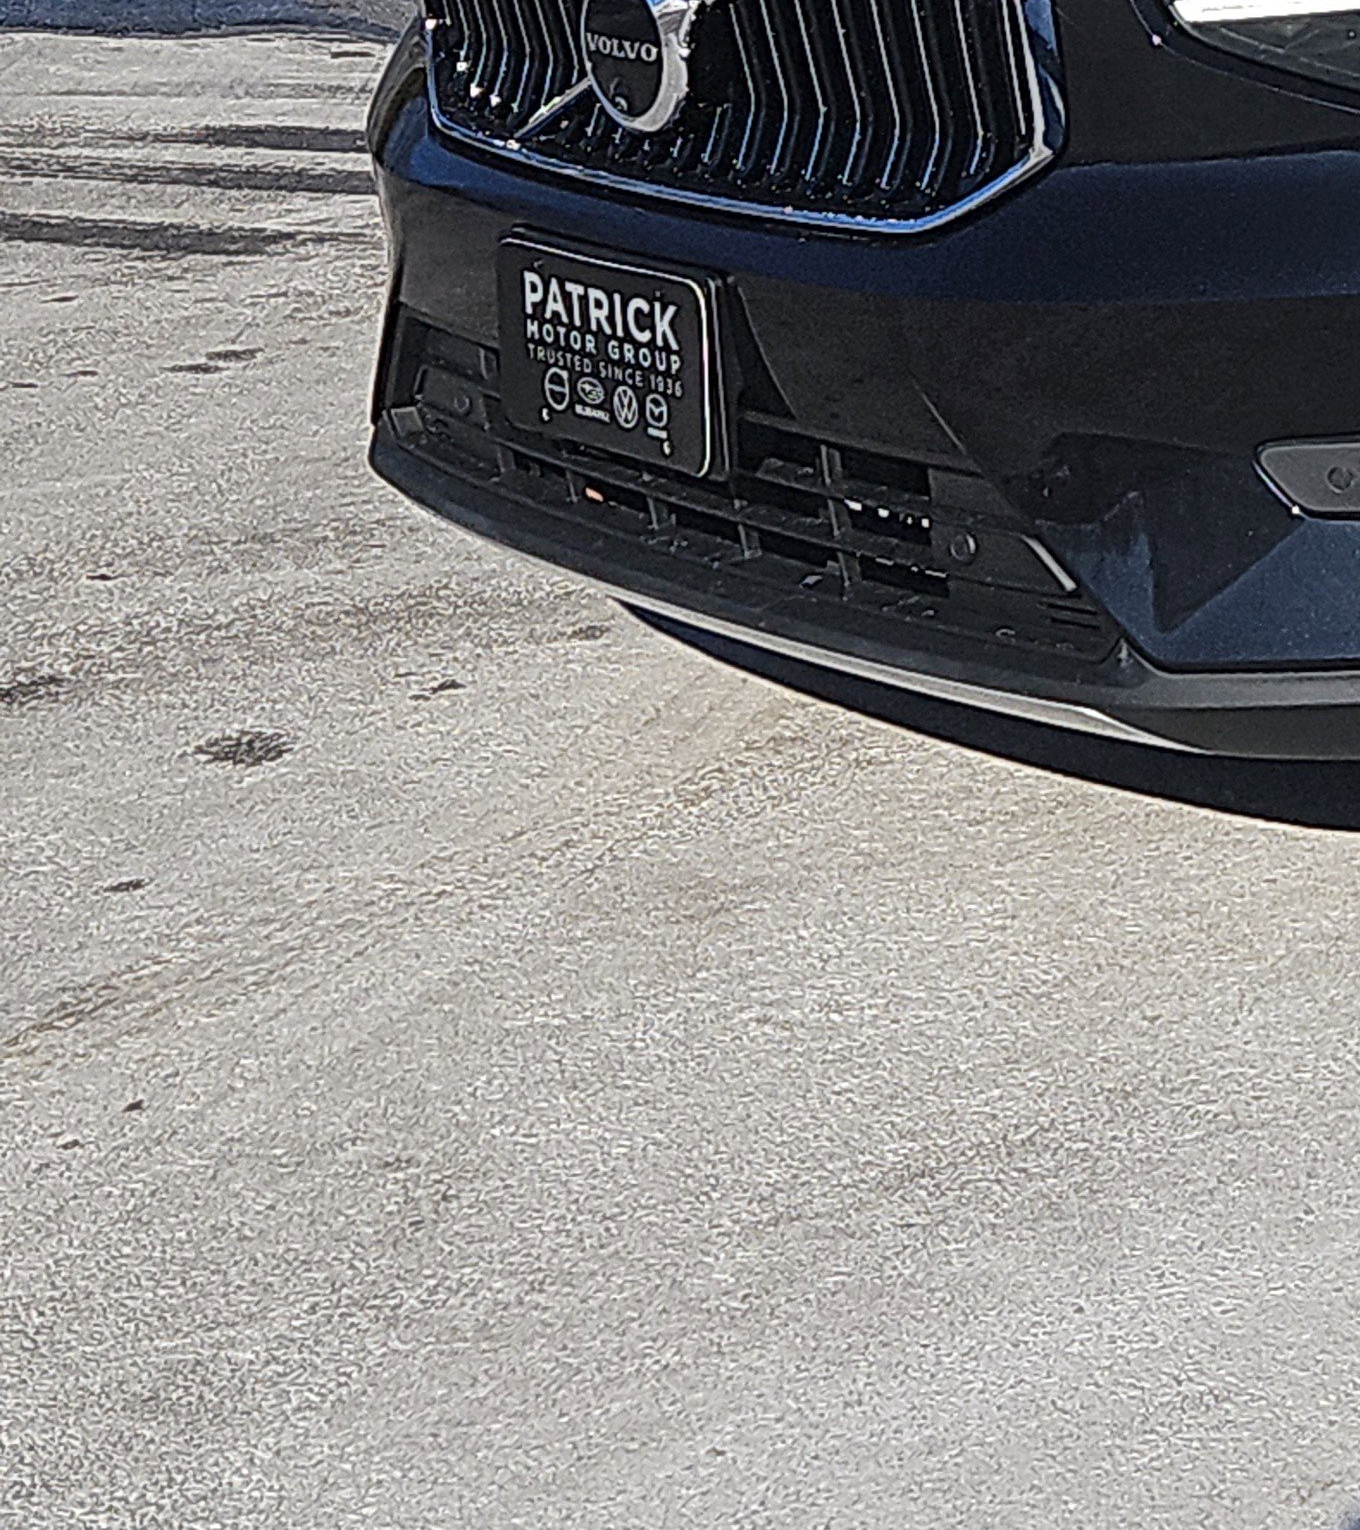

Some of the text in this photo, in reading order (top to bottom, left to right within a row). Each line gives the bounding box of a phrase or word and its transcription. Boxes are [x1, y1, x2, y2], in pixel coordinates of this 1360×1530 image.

[586, 32, 659, 62] VOLVO
[523, 271, 679, 351] PATRICK
[526, 319, 681, 374] MOTOR GROUP
[528, 343, 592, 373] TRUSTED
[599, 362, 644, 387] SINCE
